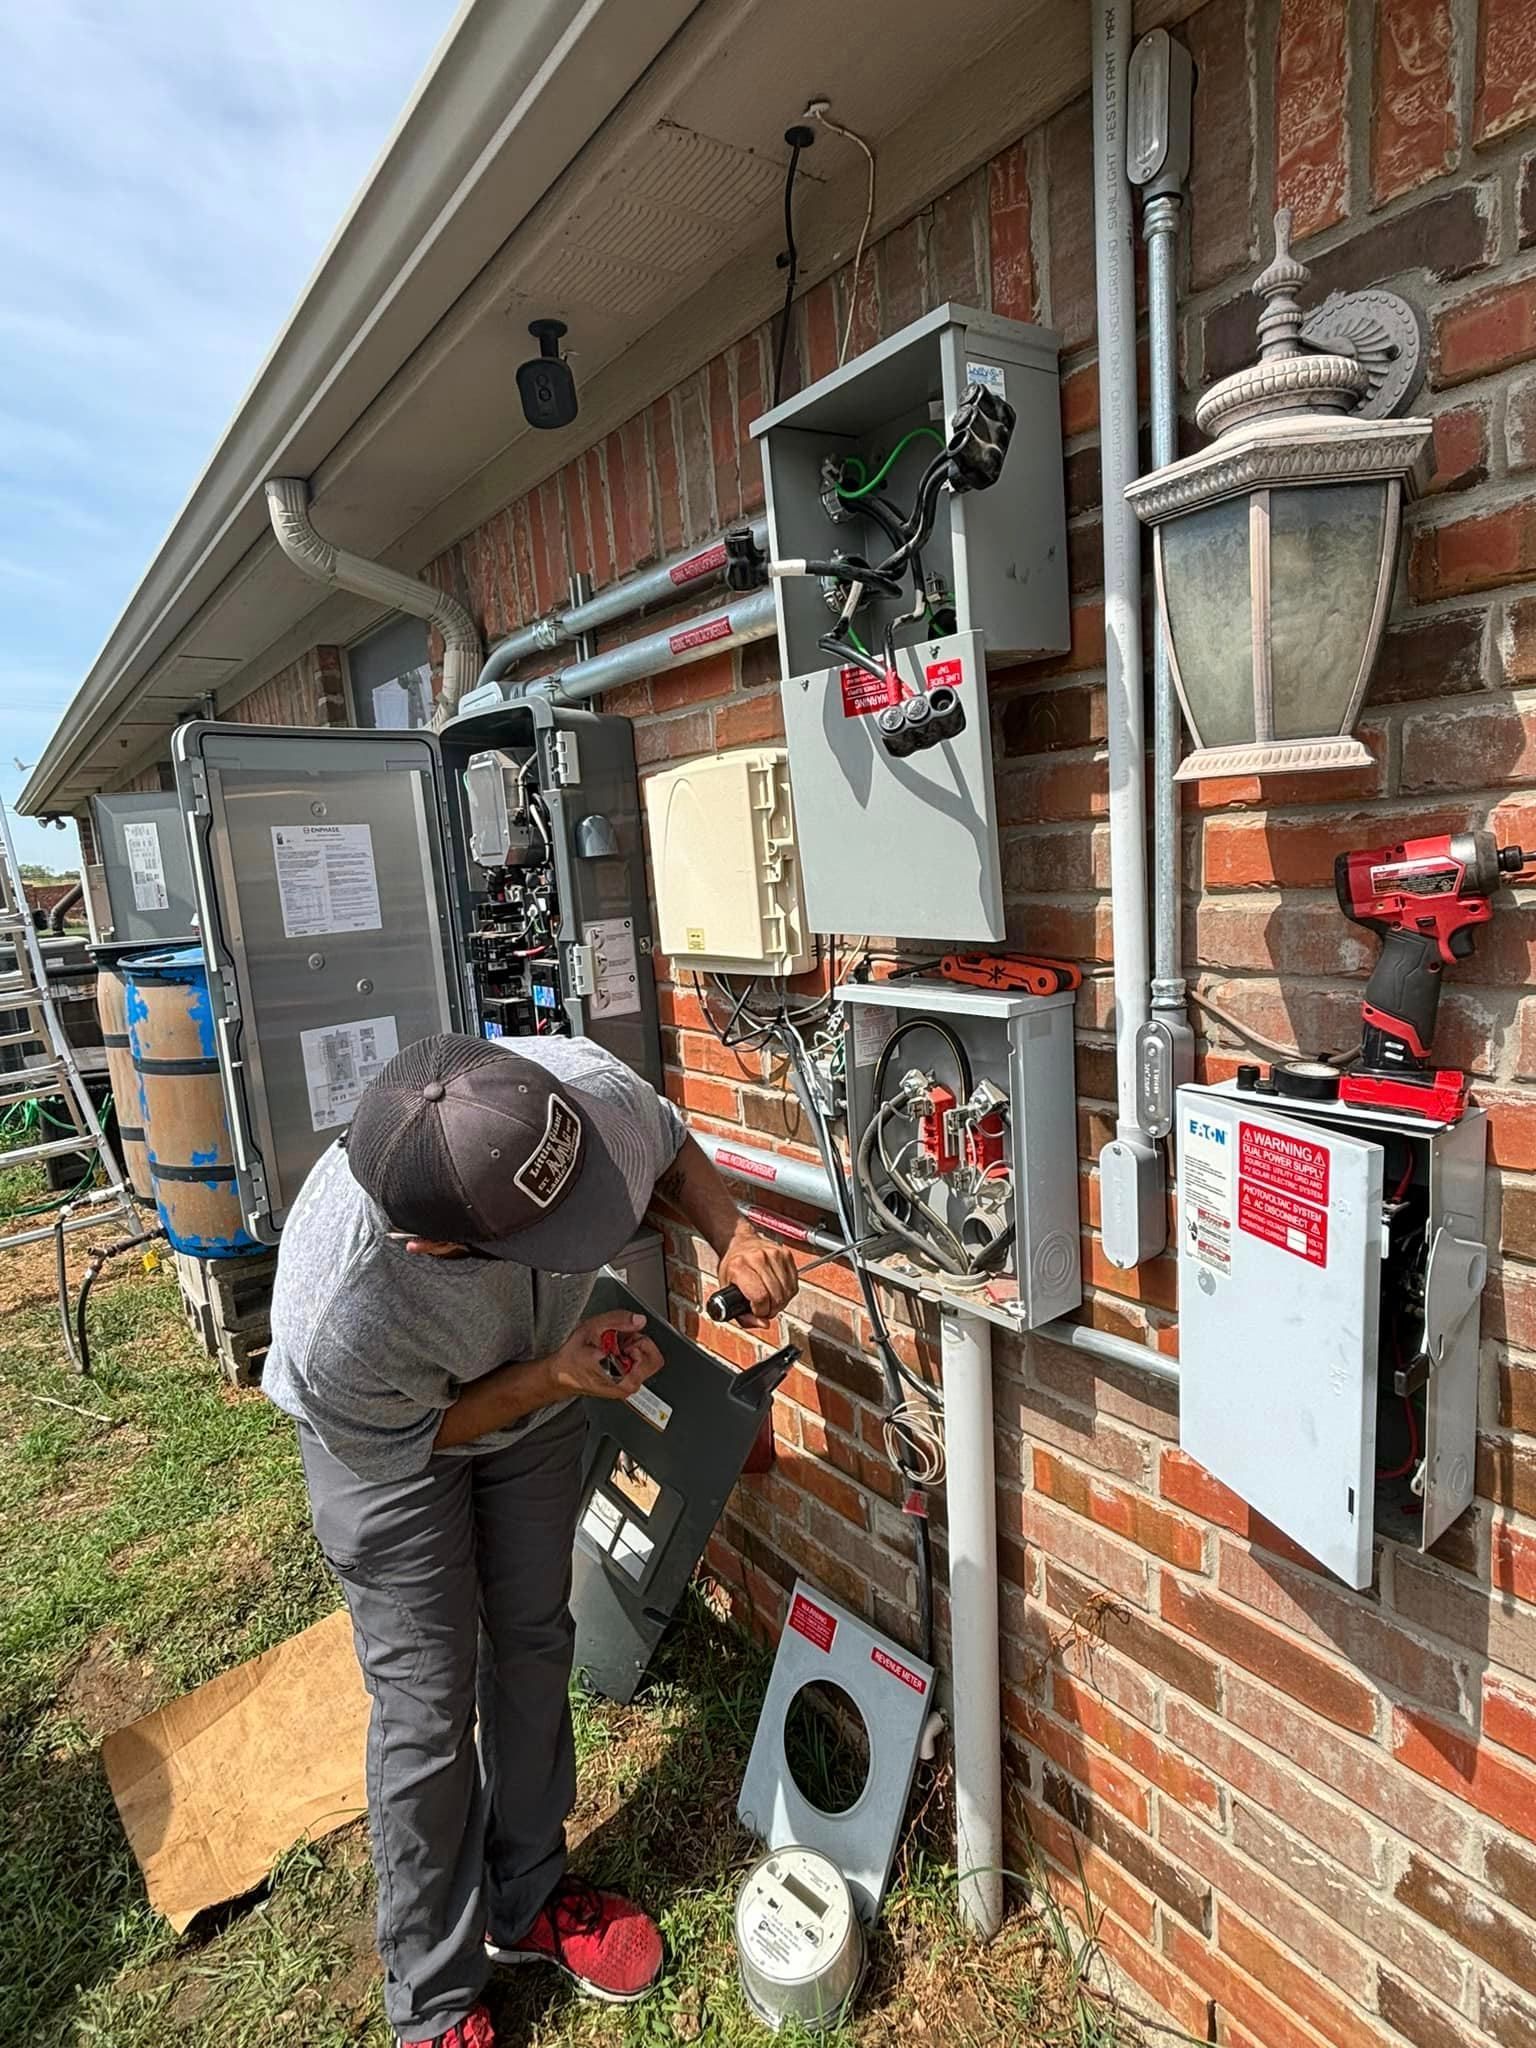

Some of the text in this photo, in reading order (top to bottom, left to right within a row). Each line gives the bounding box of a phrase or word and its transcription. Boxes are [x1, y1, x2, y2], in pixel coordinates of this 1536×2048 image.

[1105, 7, 1116, 41] MAX
[1105, 50, 1117, 142] RESISTANT
[1106, 152, 1119, 230] SUNLIGHT
[1107, 239, 1121, 344] UNDERGROUND
[529, 1107, 563, 1179] Little Giant
[1242, 1143, 1325, 1180] DUAL POWER SUPPLY
[1253, 1131, 1313, 1162] WARNING
[1252, 1167, 1270, 1180] SOLAR
[1270, 1174, 1298, 1191] ELECTRIC
[1298, 1184, 1323, 1200] SYSTEM
[1309, 1179, 1323, 1190] AND
[1242, 1183, 1322, 1223] PHOTOVOLTAIC SYSTEM
[1254, 1199, 1308, 1230] AC DISCONNECT
[801, 1602, 828, 1625] WARNING
[874, 1650, 922, 1688] REVENUE METER
